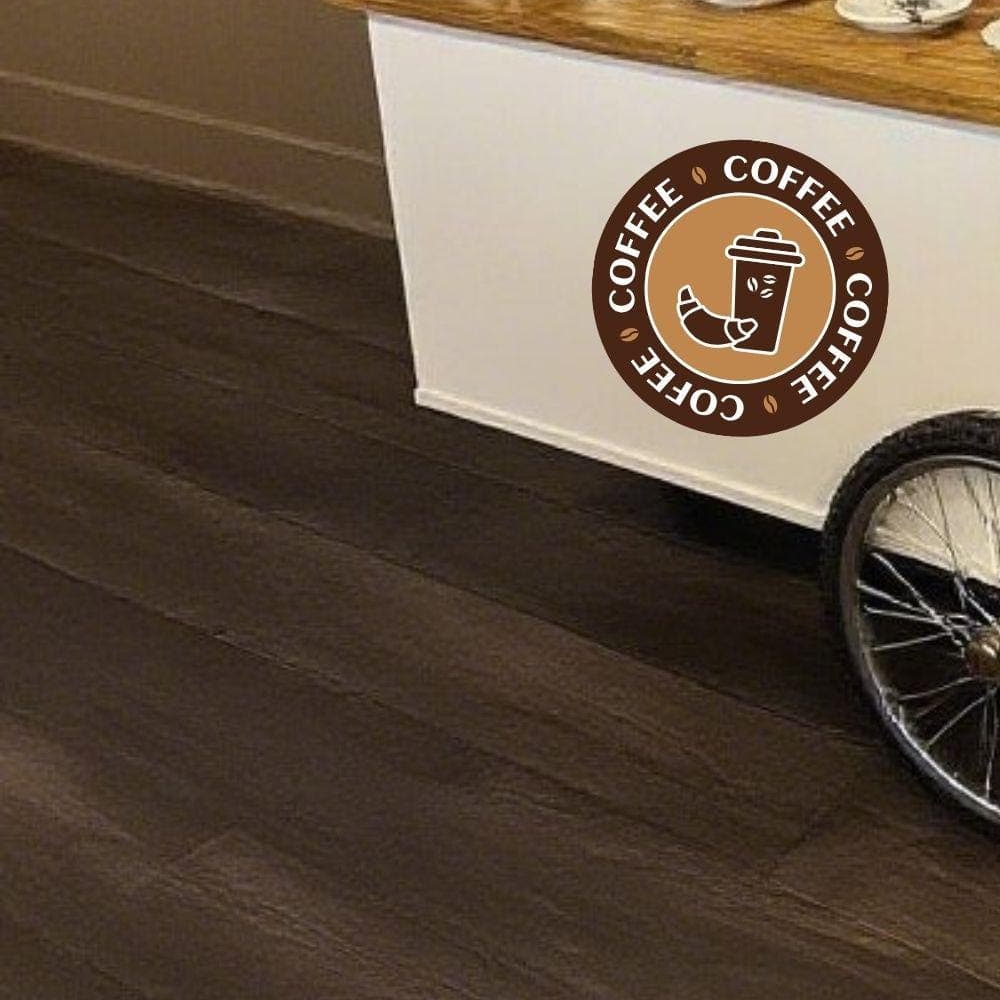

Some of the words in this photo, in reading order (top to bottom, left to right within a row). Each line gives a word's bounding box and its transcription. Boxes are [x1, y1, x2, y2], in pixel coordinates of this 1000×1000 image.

[608, 177, 684, 313] COFFEE
[723, 155, 856, 237] COFFEE
[630, 346, 745, 421] COFEE
[790, 272, 873, 404] COFFEE
